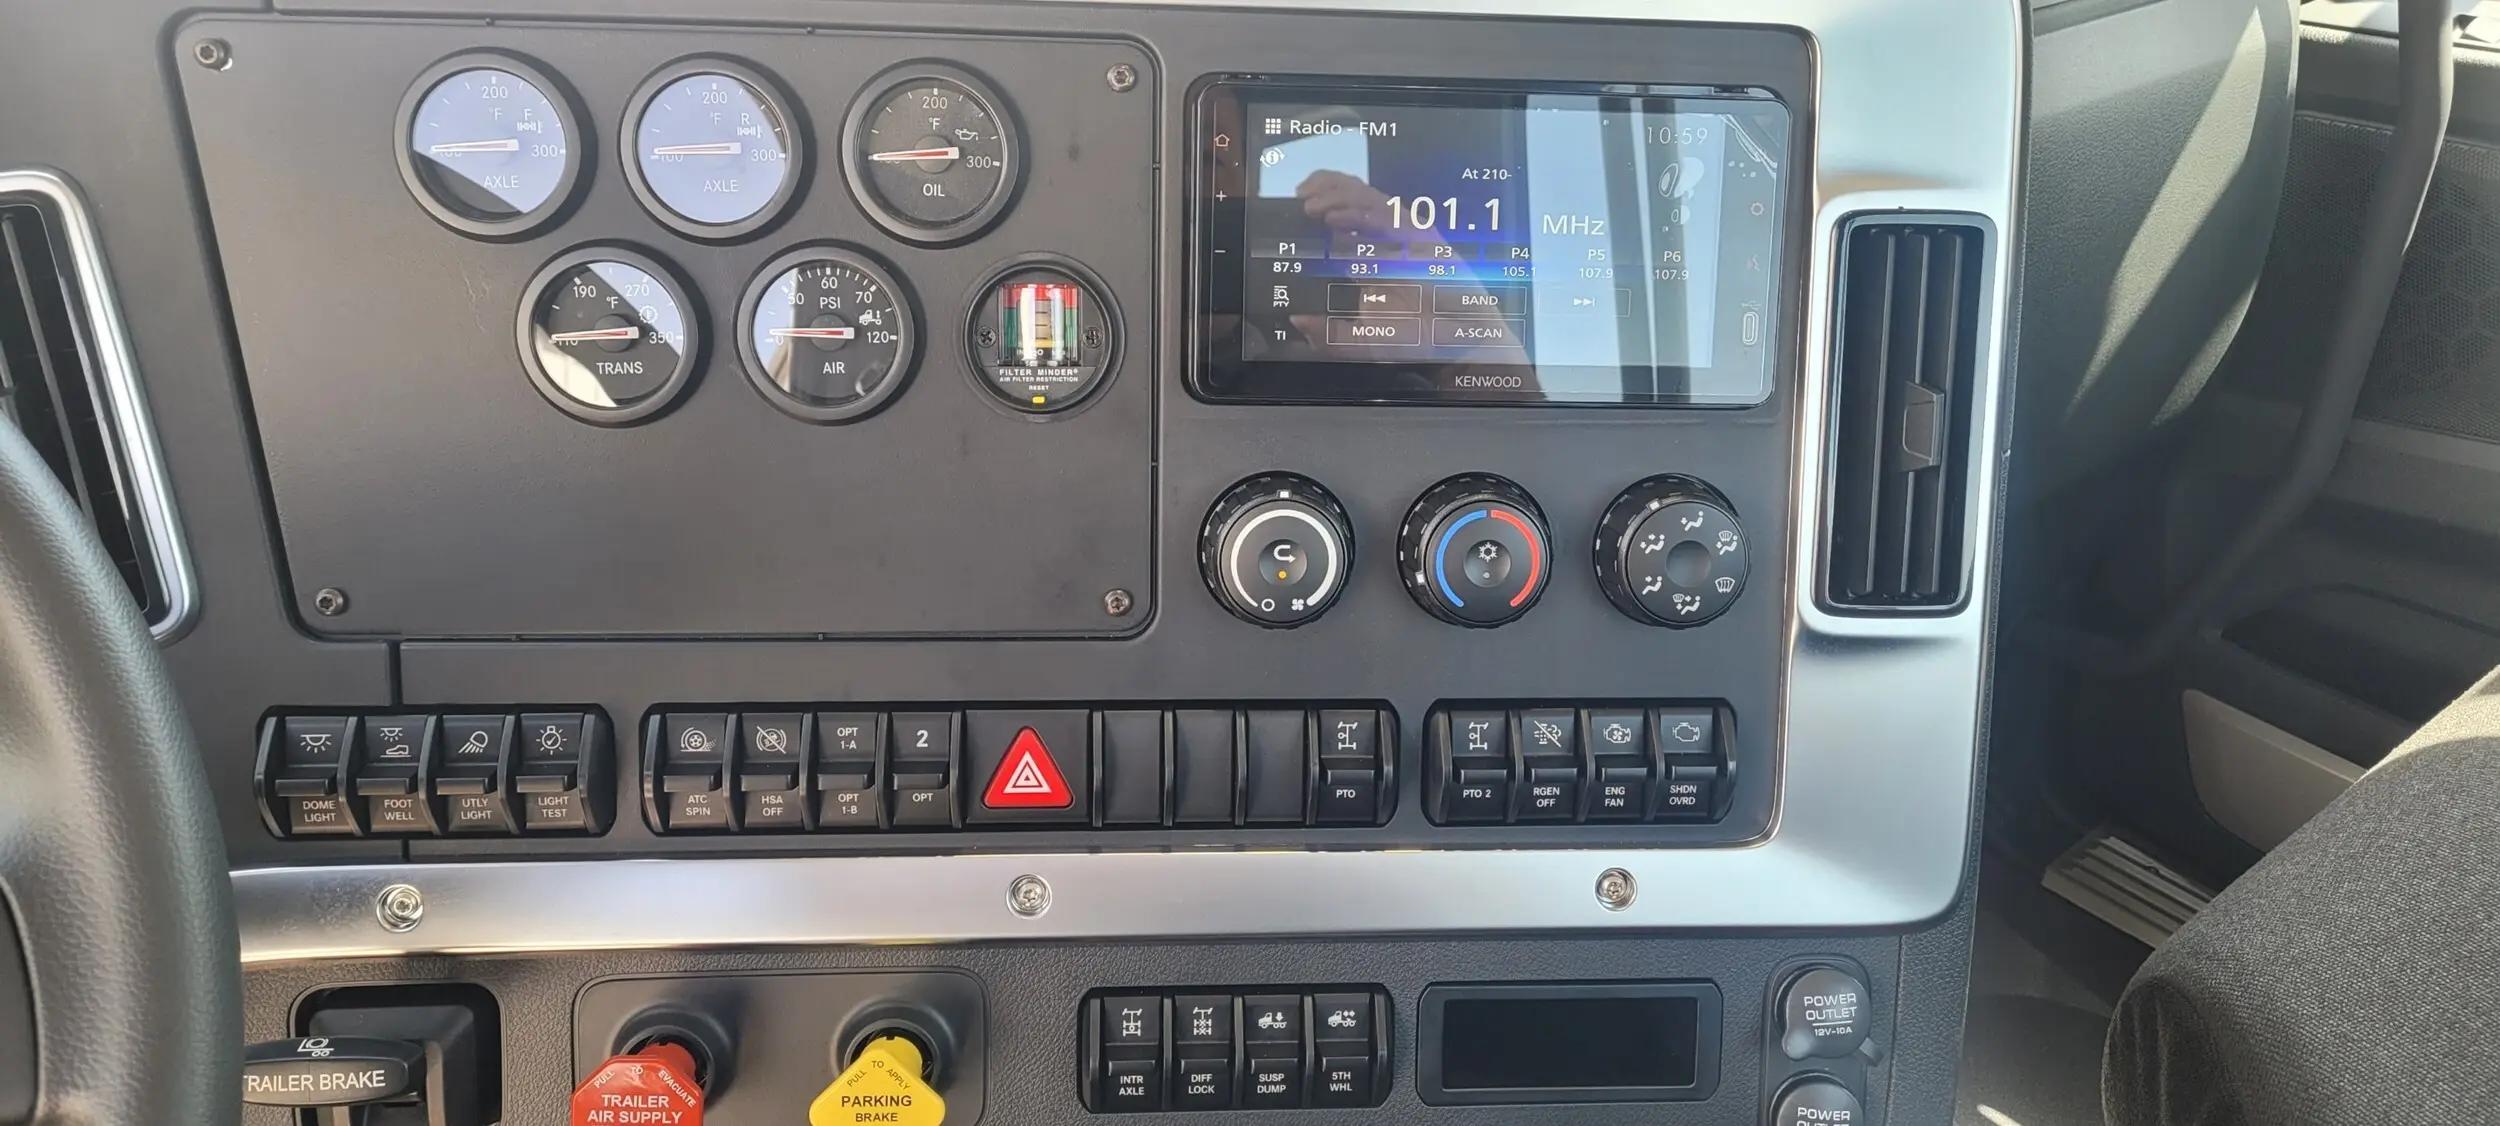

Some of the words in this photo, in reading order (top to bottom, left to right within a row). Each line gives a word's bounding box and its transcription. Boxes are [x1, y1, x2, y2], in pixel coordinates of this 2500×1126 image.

[482, 86, 508, 99] 200
[702, 91, 727, 105] 200
[922, 97, 948, 109] 200
[524, 109, 532, 120] F
[741, 113, 750, 125] R
[1290, 120, 1342, 135] Radio
[1359, 121, 1397, 137] FM1
[1648, 126, 1708, 144] 10:59
[531, 145, 558, 158] 300
[751, 149, 777, 162] 300
[966, 156, 991, 169] 300
[1462, 168, 1479, 180] At
[483, 176, 520, 188] AXLE
[704, 180, 739, 192] AXLE
[923, 184, 944, 197] OIL
[1386, 196, 1500, 231] 101.1
[1543, 215, 1605, 235] MHz
[1279, 243, 1296, 255] P1
[1357, 245, 1376, 257] P2
[1434, 246, 1452, 258] P3
[1511, 248, 1529, 259] P4
[1588, 249, 1605, 261] P5
[1663, 251, 1681, 262] P6
[1273, 262, 1302, 274] 87.9
[1351, 263, 1379, 275] 93.1
[1428, 265, 1456, 276] 98.1
[1503, 267, 1536, 277] 105.1
[1579, 268, 1613, 279] 107.9
[1655, 269, 1689, 280] 107.9
[821, 277, 838, 289] 60
[573, 286, 596, 298] 190
[624, 284, 650, 297] 270
[820, 297, 840, 309] PSI
[855, 292, 872, 304] 70
[1462, 295, 1498, 306] BAND
[1274, 330, 1286, 340] TI
[1352, 326, 1395, 337] MONO
[1454, 328, 1502, 338] A-SCAN
[649, 331, 674, 344] 350
[867, 332, 889, 344] 120
[596, 362, 643, 374] TRANS
[822, 362, 845, 374] AIR
[1455, 376, 1522, 388] KENWOOD
[837, 727, 858, 737] OPT
[916, 730, 929, 748] 2
[840, 740, 857, 750] 1-A
[1336, 789, 1356, 799] PTO
[1463, 789, 1482, 799] PTO
[1485, 789, 1491, 799] 2
[1533, 787, 1560, 796] RGEN
[1604, 787, 1625, 796] ENG
[1670, 785, 1697, 794] SHDN
[462, 798, 489, 808] UTLY
[538, 796, 569, 806] LIGHT
[687, 795, 708, 805] ATC
[761, 795, 783, 805] HSA
[838, 793, 859, 803] OPT
[912, 793, 933, 803] OPT
[1536, 798, 1556, 808] OFF
[1604, 798, 1624, 808] FAN
[1669, 796, 1696, 806] OVRD
[303, 800, 336, 810] DOME
[384, 799, 413, 809] FOOT
[461, 809, 492, 820] LIGHT
[542, 808, 568, 818] TEST
[686, 807, 711, 816] SPIN
[762, 807, 783, 817] OFF
[842, 805, 858, 815] 1-B
[304, 812, 336, 823] LIGHT
[385, 811, 415, 821] WELL
[1803, 993, 1857, 1007] POWER
[1805, 1006, 1857, 1021] OUTLET
[1814, 1027, 1852, 1037] 12V-10A
[243, 1074, 314, 1092] RAILER
[320, 1070, 386, 1091] BRAKE
[847, 1069, 867, 1088] PULL
[872, 1060, 884, 1068] TO
[886, 1068, 911, 1091] APPLY
[1120, 1075, 1144, 1085] INTR
[1191, 1074, 1213, 1083] DIFF
[1258, 1073, 1285, 1082] SUSP
[1332, 1072, 1351, 1081] 5TH
[593, 1070, 615, 1088] PULL
[658, 1070, 697, 1108] EVACUATE
[1118, 1086, 1145, 1096] AXLE
[1188, 1085, 1215, 1095] LOCK
[1257, 1084, 1286, 1093] DUMP
[1330, 1083, 1352, 1092] WHL
[601, 1094, 669, 1108] TRAILER
[841, 1095, 912, 1108] PARKING
[587, 1110, 615, 1123] AIR
[619, 1111, 683, 1124] SUPPLY
[855, 1112, 898, 1123] BRAKE
[1798, 1106, 1850, 1121] POWER
